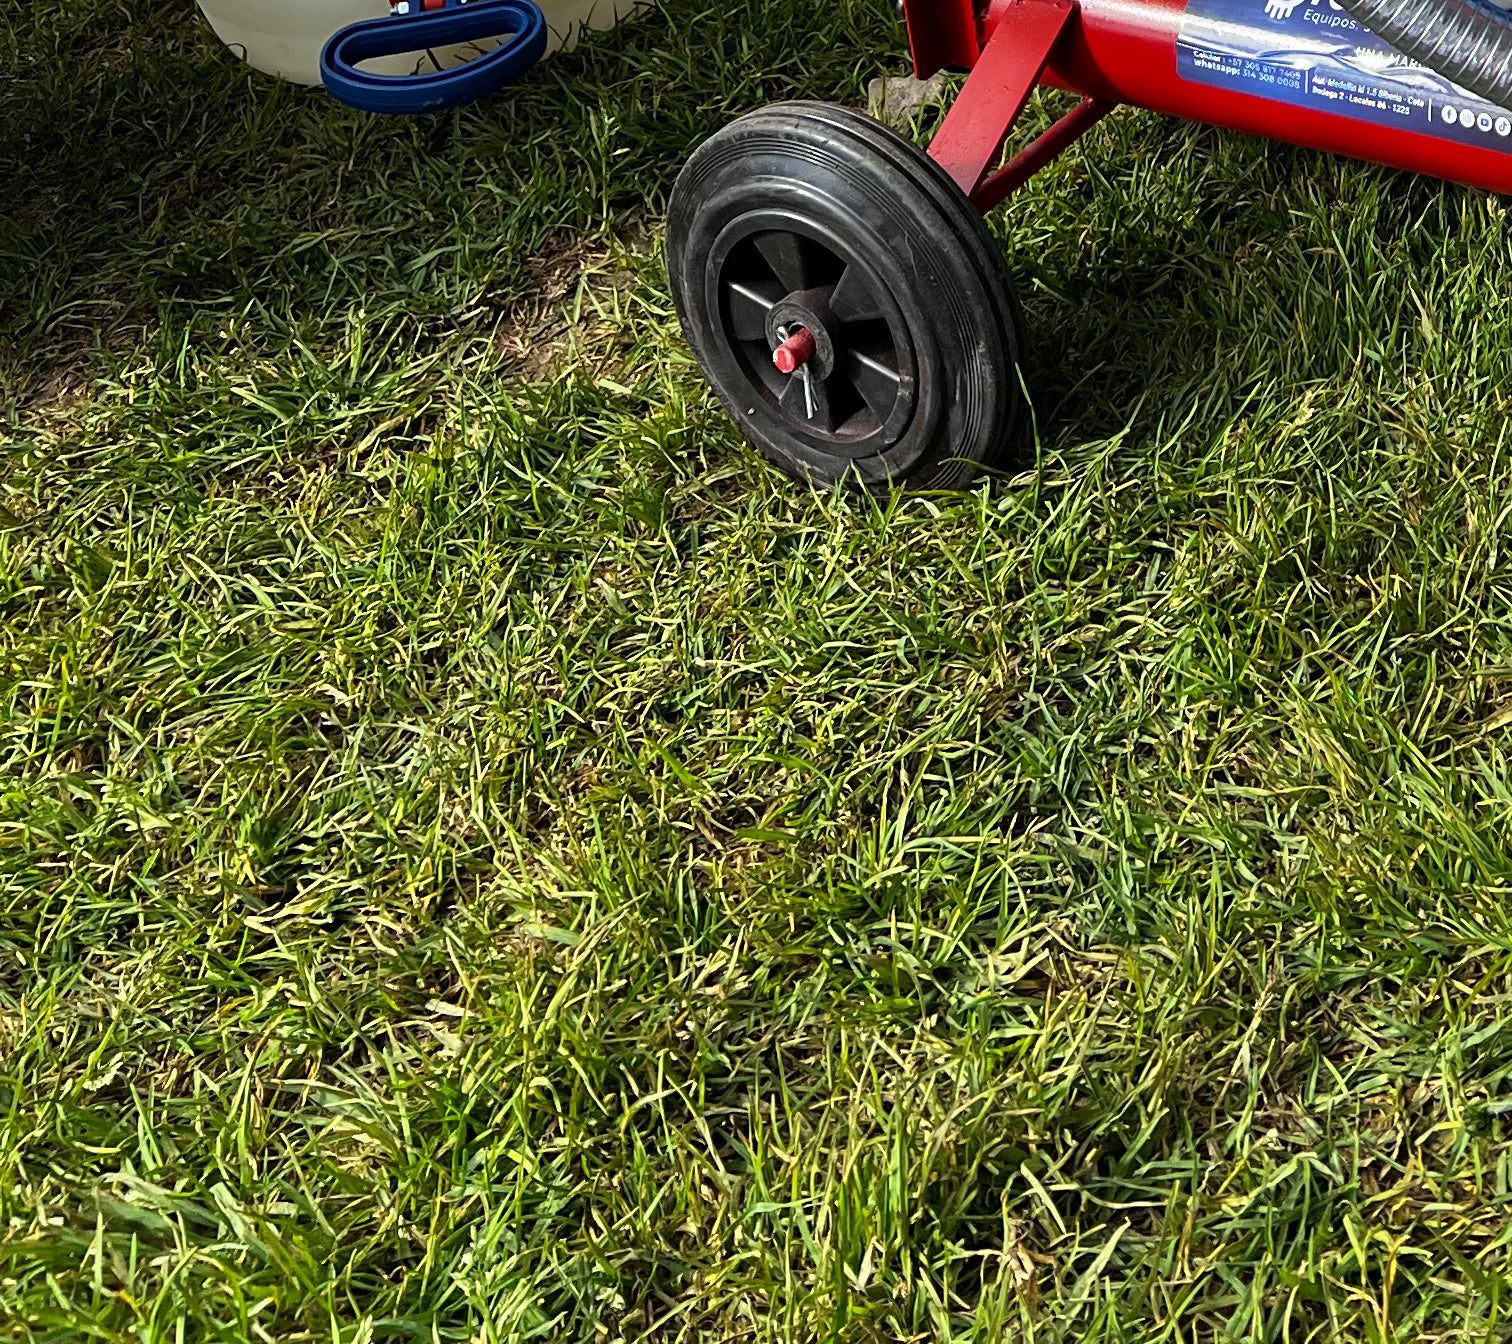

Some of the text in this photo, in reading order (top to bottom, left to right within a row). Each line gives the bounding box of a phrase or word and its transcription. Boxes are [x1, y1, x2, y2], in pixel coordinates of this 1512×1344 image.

[1303, 8, 1359, 32] Equipos,
[1227, 57, 1243, 66] +57
[1242, 68, 1257, 79] 314
[1258, 71, 1275, 83] 308
[1349, 93, 1377, 108] Locales
[1407, 95, 1425, 108] Cota
